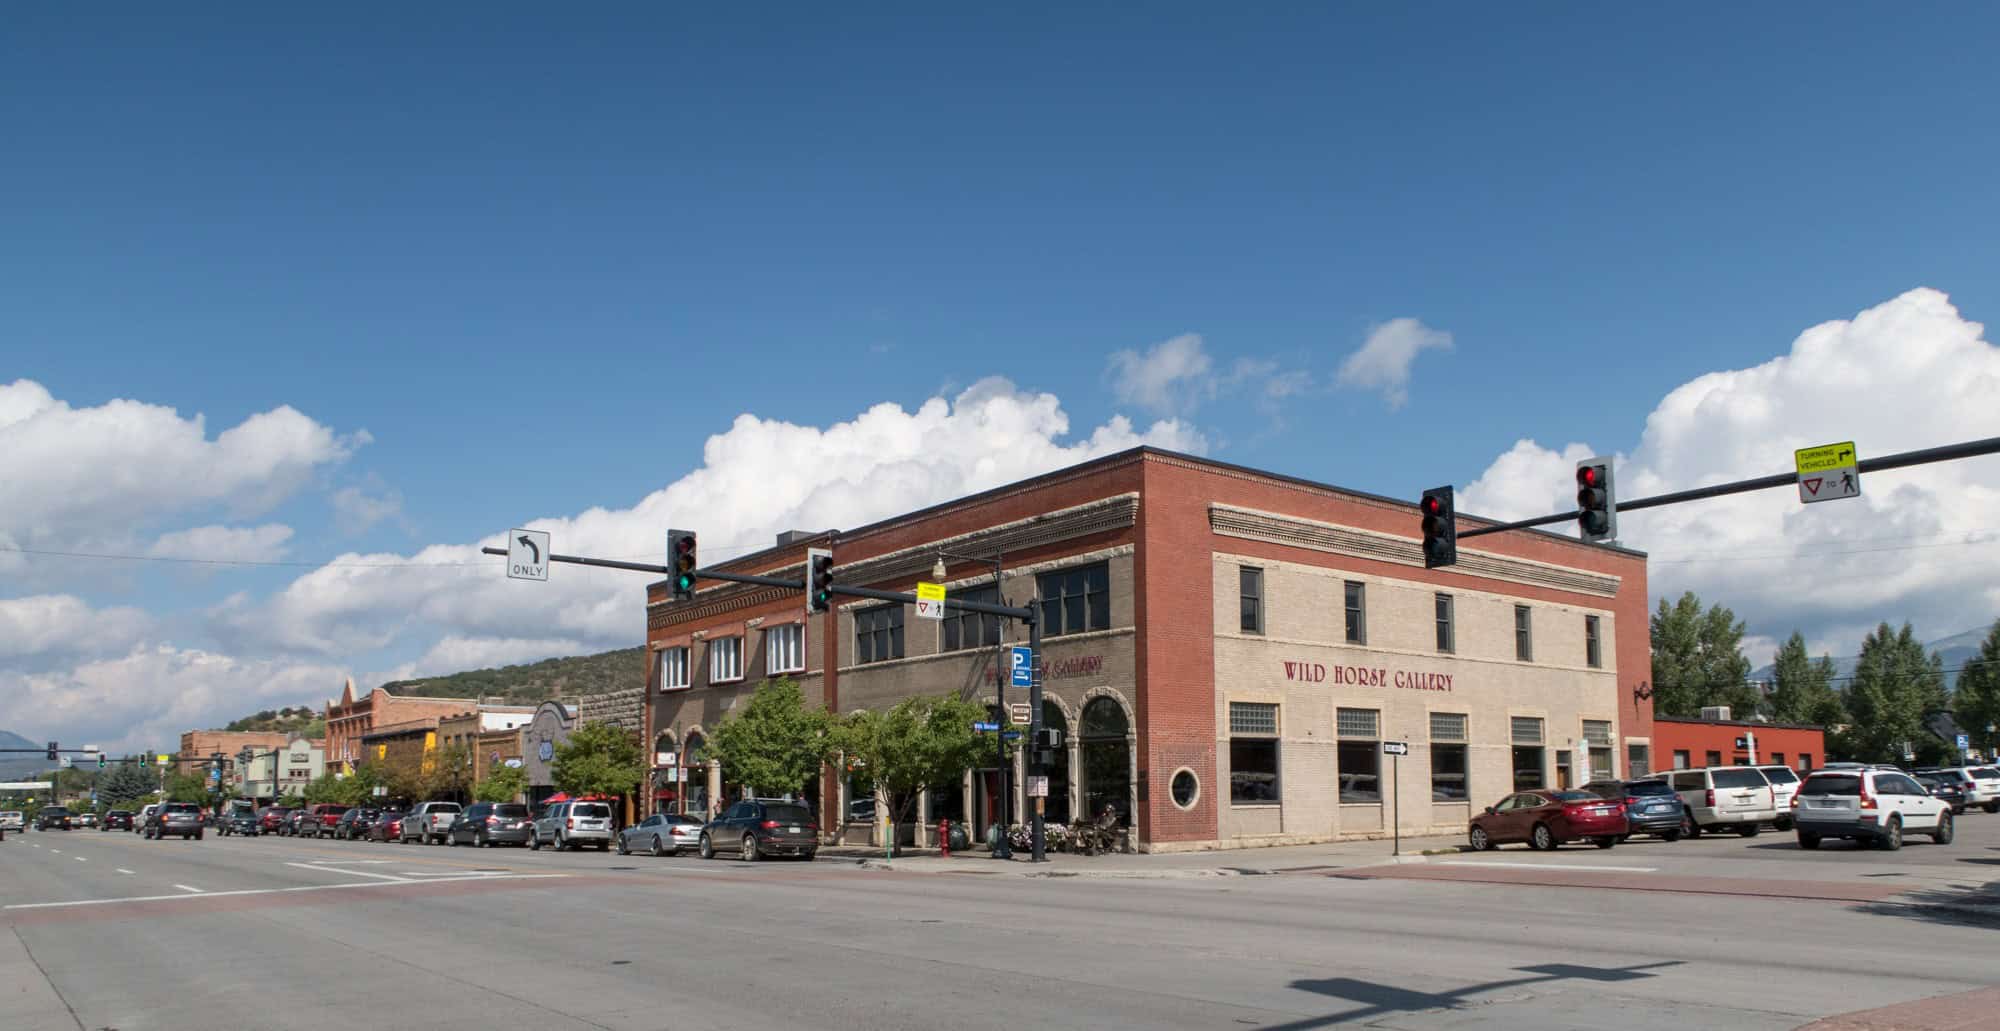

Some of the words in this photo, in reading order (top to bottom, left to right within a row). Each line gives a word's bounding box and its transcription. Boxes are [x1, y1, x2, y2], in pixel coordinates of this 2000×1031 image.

[1801, 449, 1834, 459] TURNING
[1800, 459, 1837, 469] VEHICLES
[1826, 480, 1837, 488] TO
[513, 564, 543, 577] ONLY
[1013, 652, 1024, 670] P
[1284, 661, 1326, 683] WILD
[1334, 665, 1387, 688] HORSE
[1394, 671, 1453, 692] GALLERY
